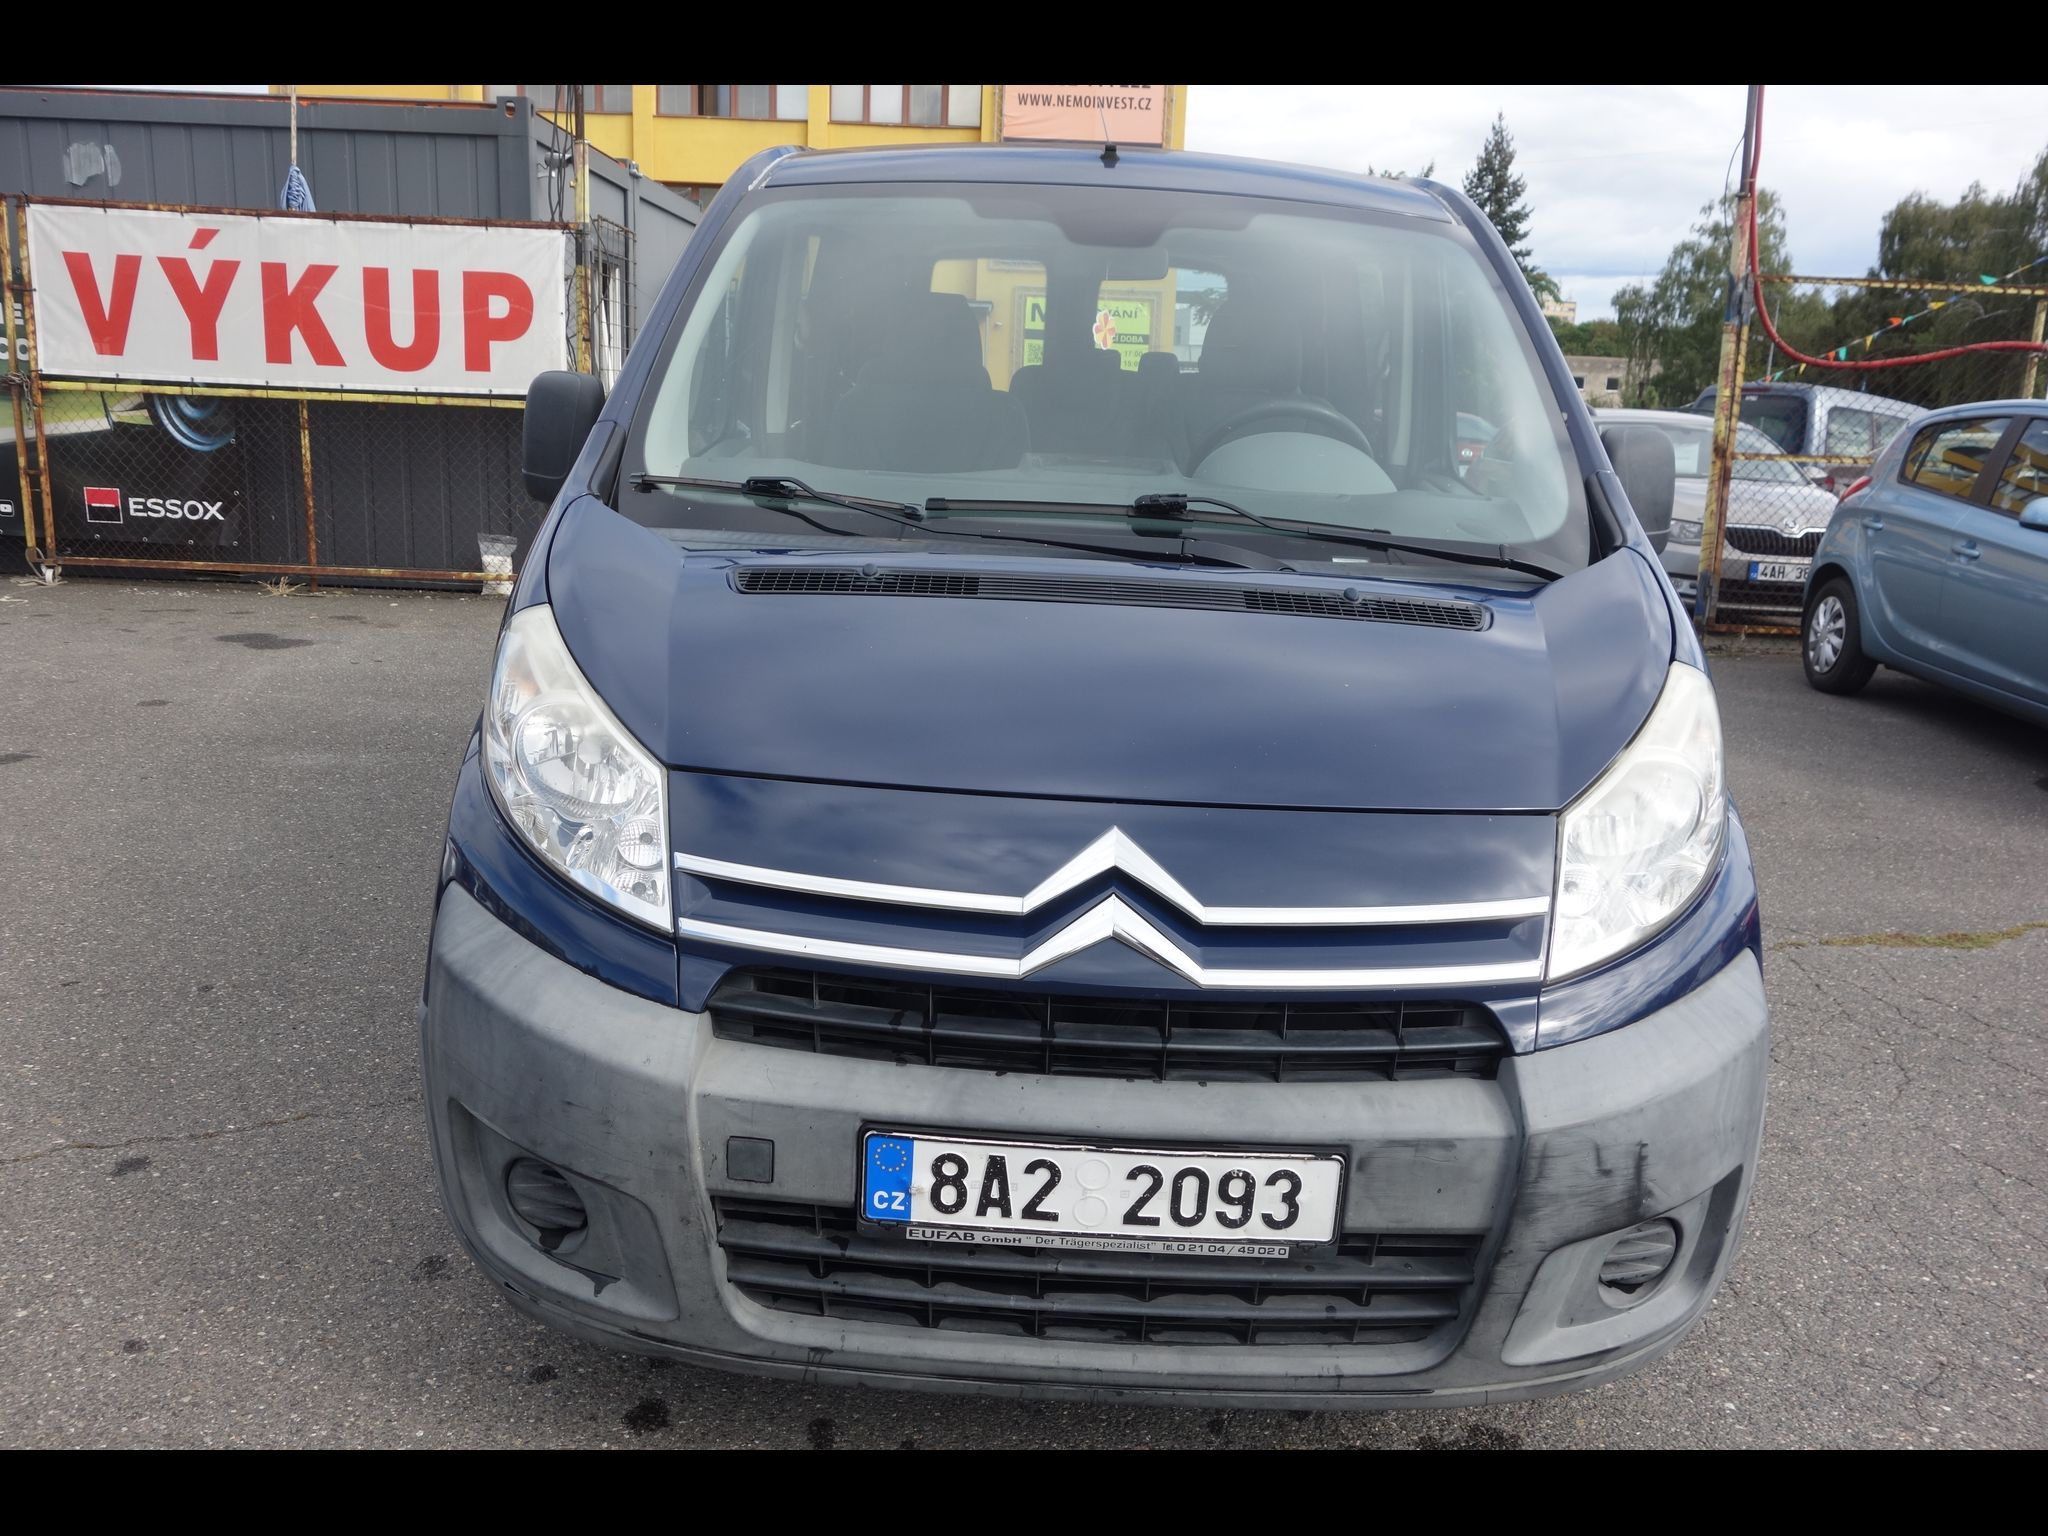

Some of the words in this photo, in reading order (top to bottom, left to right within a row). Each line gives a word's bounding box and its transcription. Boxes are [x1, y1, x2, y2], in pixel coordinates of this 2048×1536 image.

[1018, 93, 1152, 110] WWW.NEMOINVEST.CZ
[62, 228, 534, 372] VÝKUP
[129, 497, 225, 521] ESSOX
[1761, 565, 1786, 579] 4AH
[873, 1190, 906, 1211] CZ
[929, 1152, 1064, 1223] 8A2
[1121, 1163, 1304, 1231] 2093
[908, 1229, 975, 1242] EUFAB
[981, 1235, 1022, 1244] GmbH
[1162, 1243, 1174, 1251] Tel.
